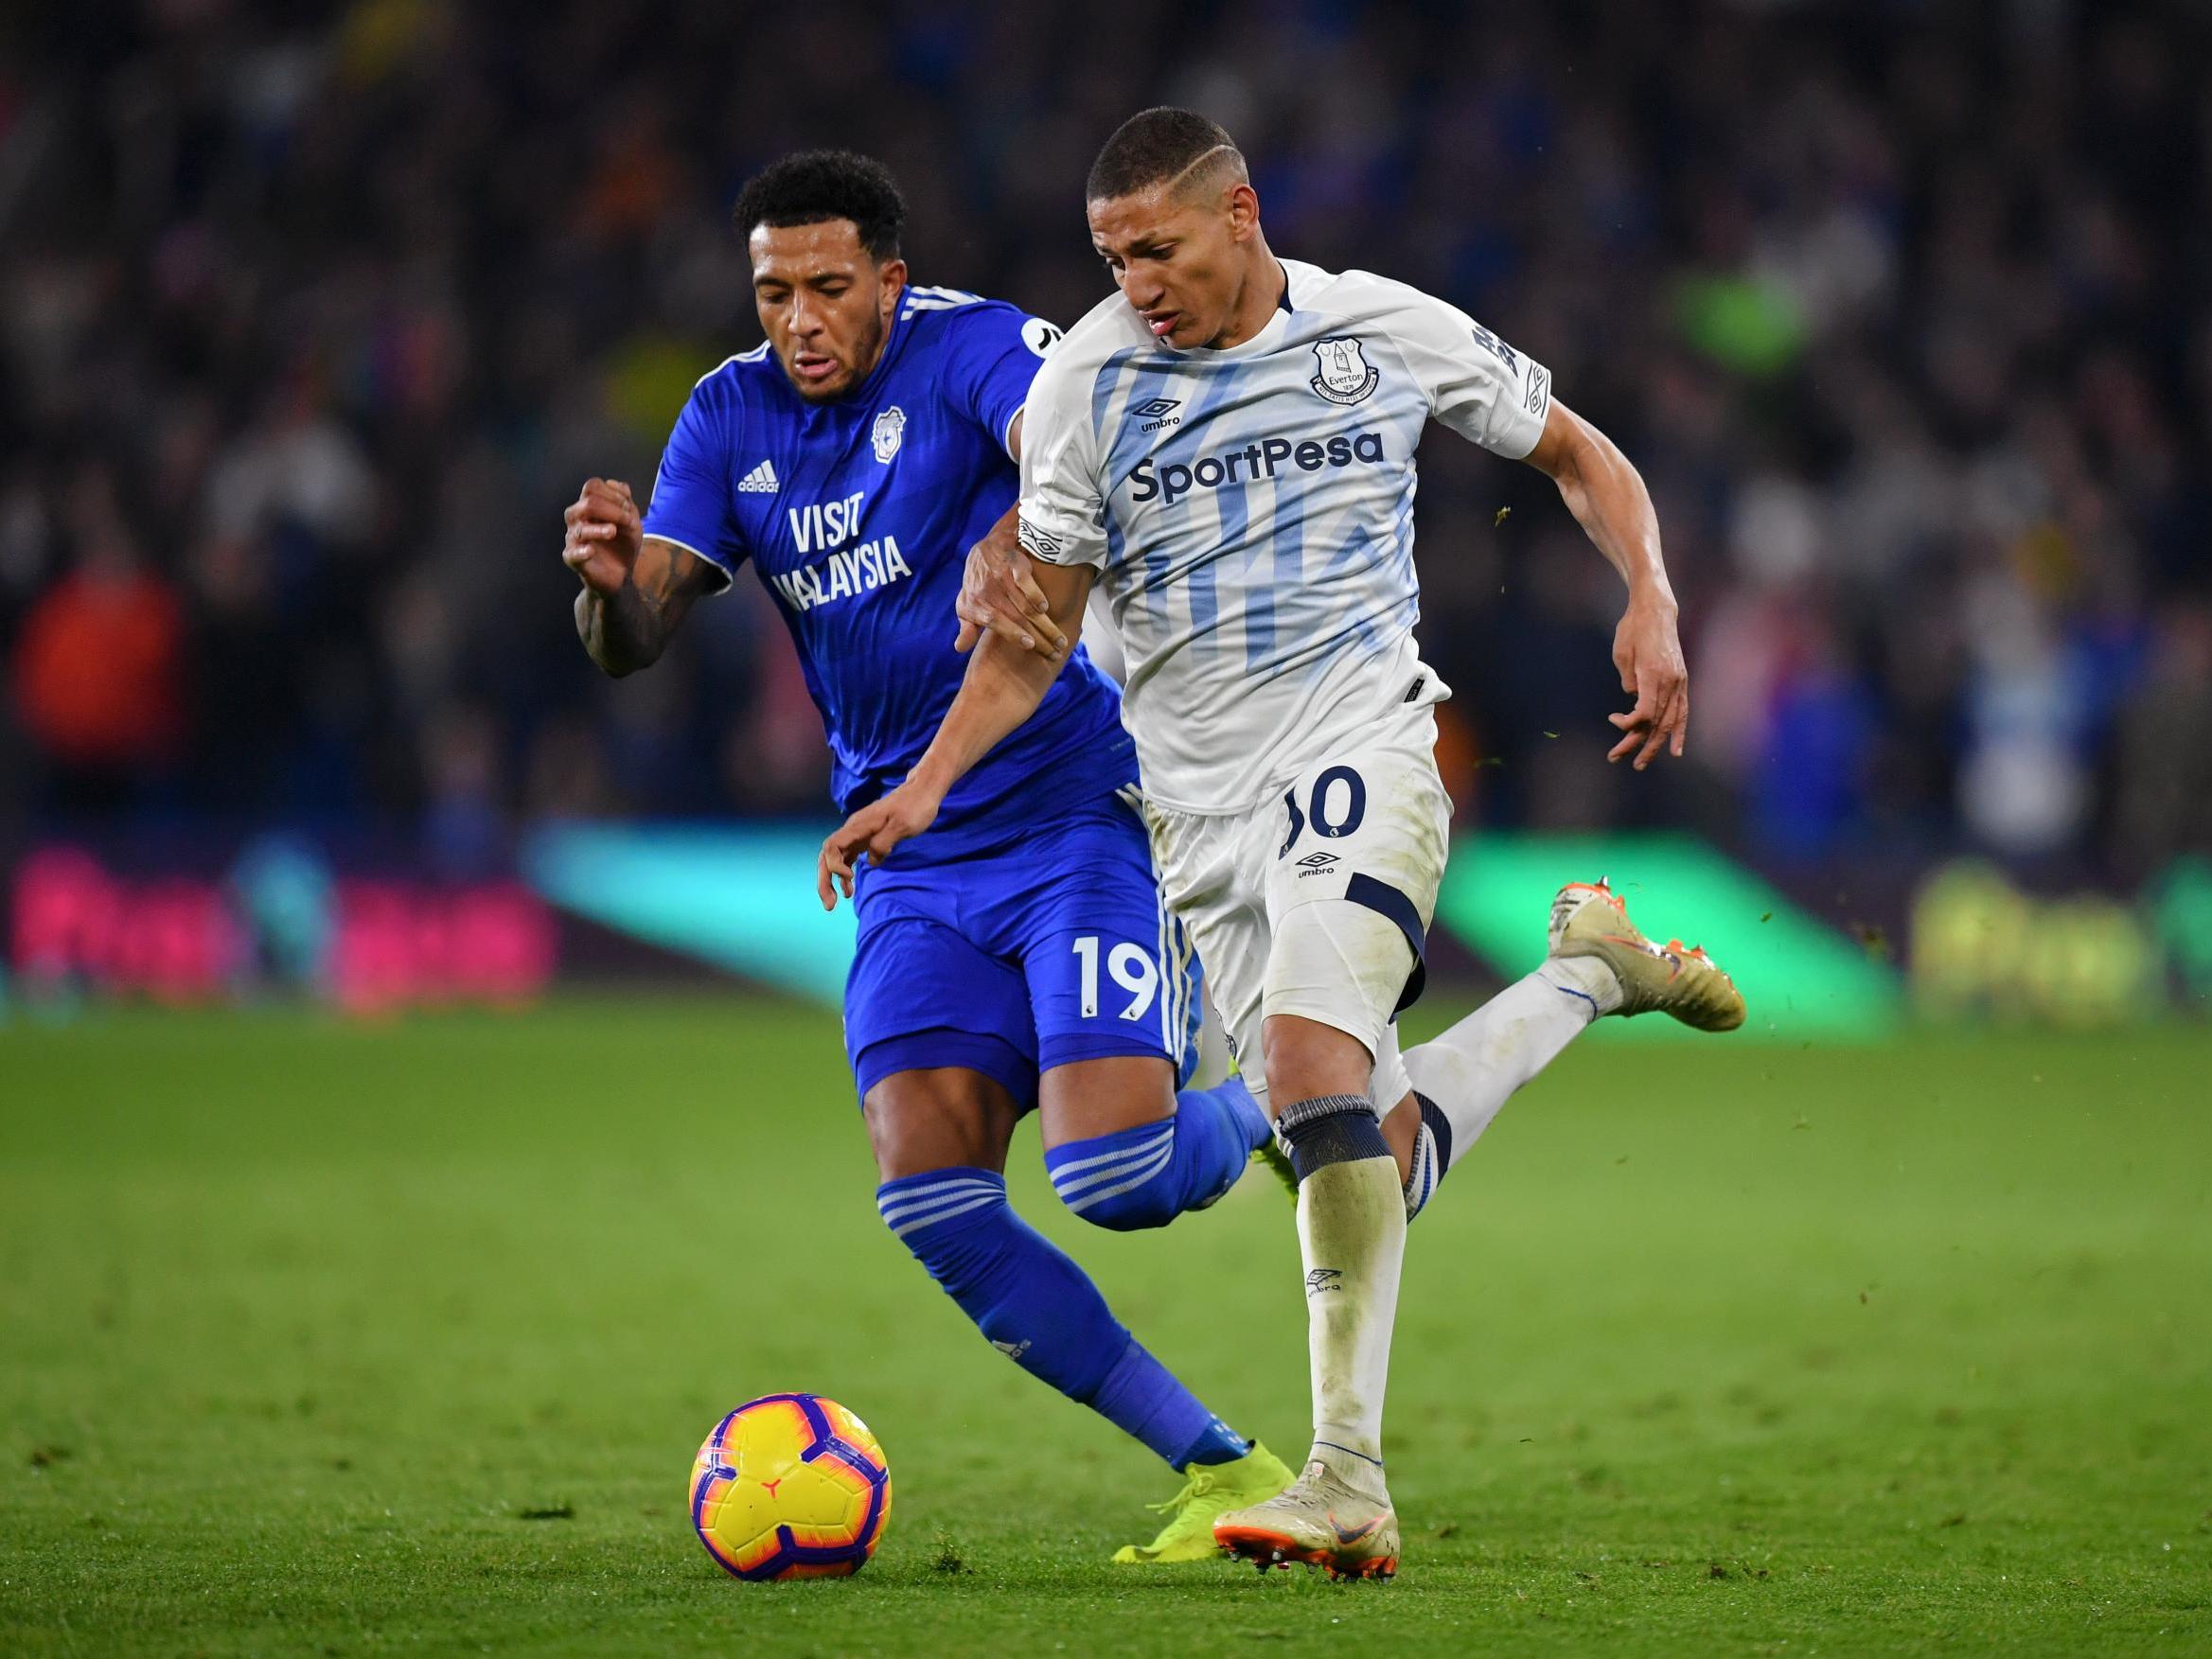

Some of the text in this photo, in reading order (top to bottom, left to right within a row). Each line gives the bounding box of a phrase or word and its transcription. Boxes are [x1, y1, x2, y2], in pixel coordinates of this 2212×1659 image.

[1329, 374, 1364, 385] Everton
[1141, 417, 1179, 432] umbro
[1129, 432, 1384, 504] SportPesa
[738, 480, 779, 493] adidas
[789, 491, 864, 553] VISIT
[1299, 867, 1335, 878] umbro
[1072, 936, 1159, 1021] 19
